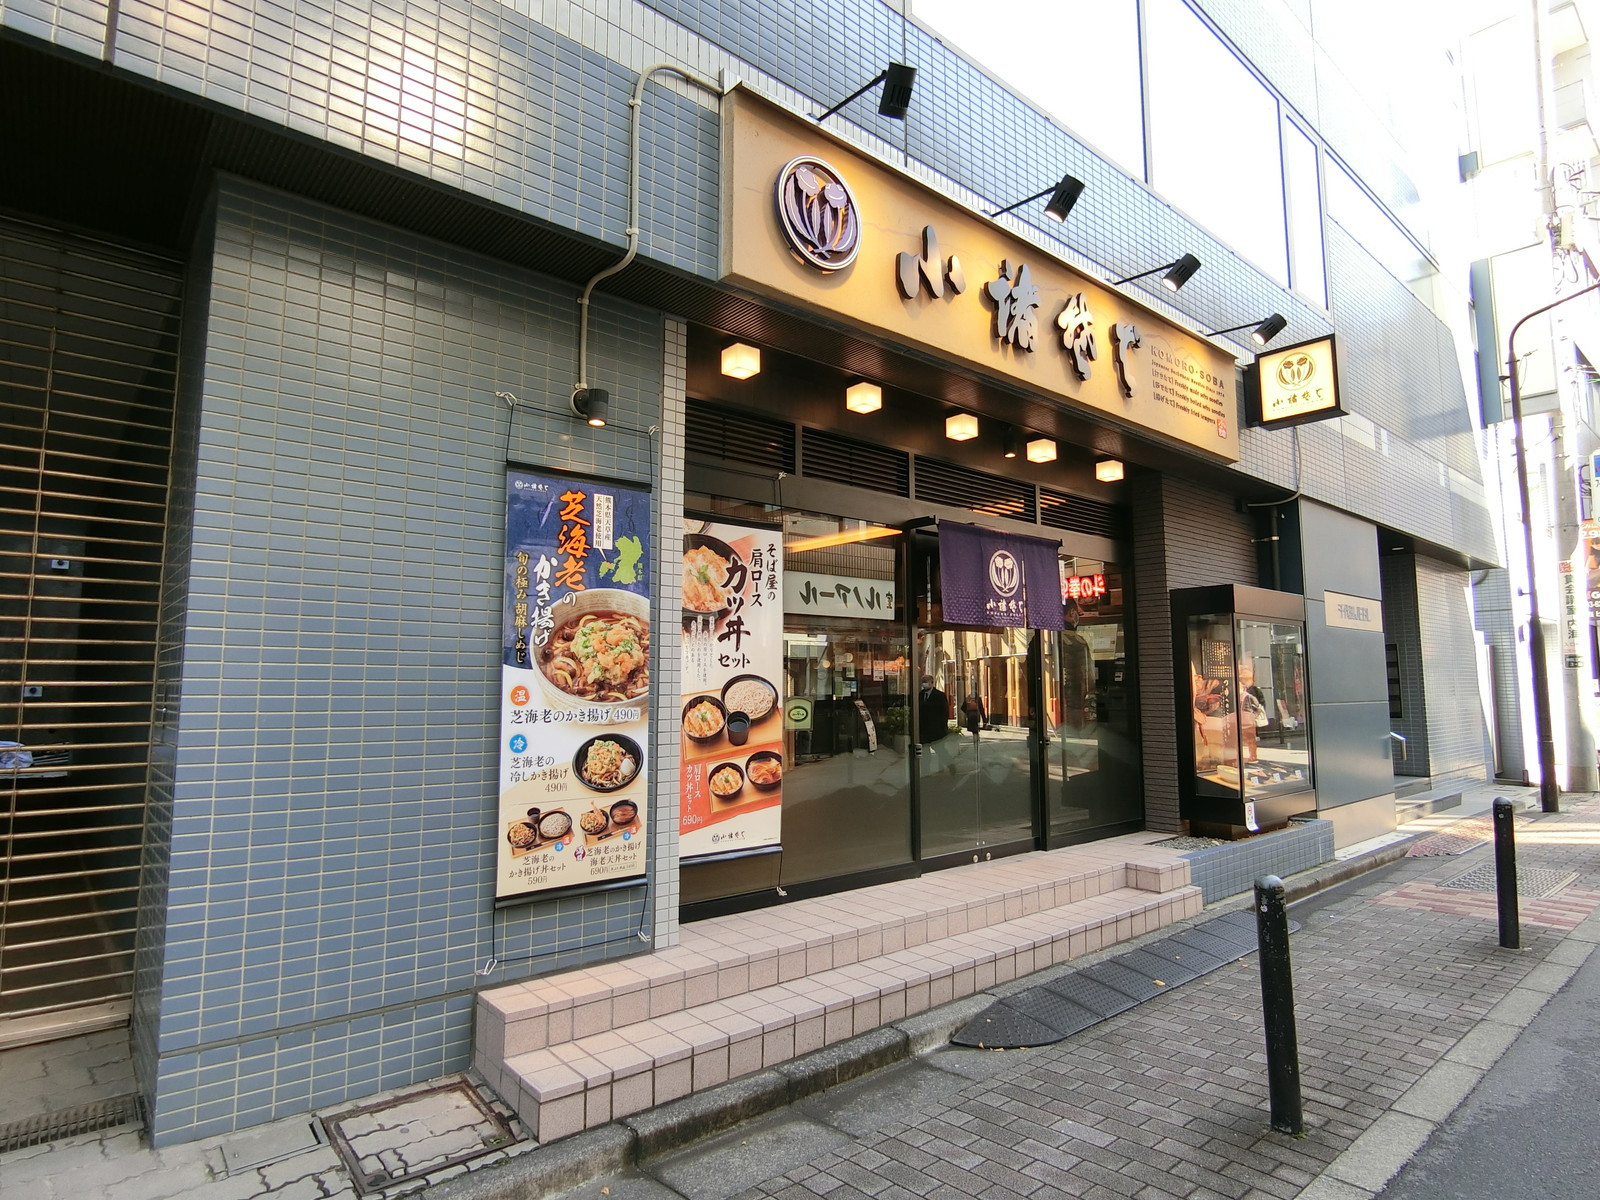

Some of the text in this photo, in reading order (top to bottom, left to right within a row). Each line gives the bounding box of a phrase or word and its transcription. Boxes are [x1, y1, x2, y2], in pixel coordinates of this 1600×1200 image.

[750, 548, 763, 607] 肩ロース
[765, 543, 778, 601] そば屋の
[531, 554, 558, 648] かき揚げ
[717, 556, 751, 652] カツ丼
[718, 652, 751, 669] セット
[510, 708, 640, 724] 芝海老のかき揚げ 490円
[510, 755, 555, 769] 芝海老の
[510, 768, 568, 783] 冷しかき揚げ
[694, 764, 702, 798] 肩ロース
[545, 782, 568, 792] 490円
[686, 764, 694, 812] カツ丼セット
[683, 815, 702, 825] 690円
[586, 841, 642, 857] 芝海老のかき揚げ
[522, 853, 555, 866] 芝海老の
[590, 853, 637, 866] 海老天丼セット
[509, 863, 566, 878] かき揚げ丼セット
